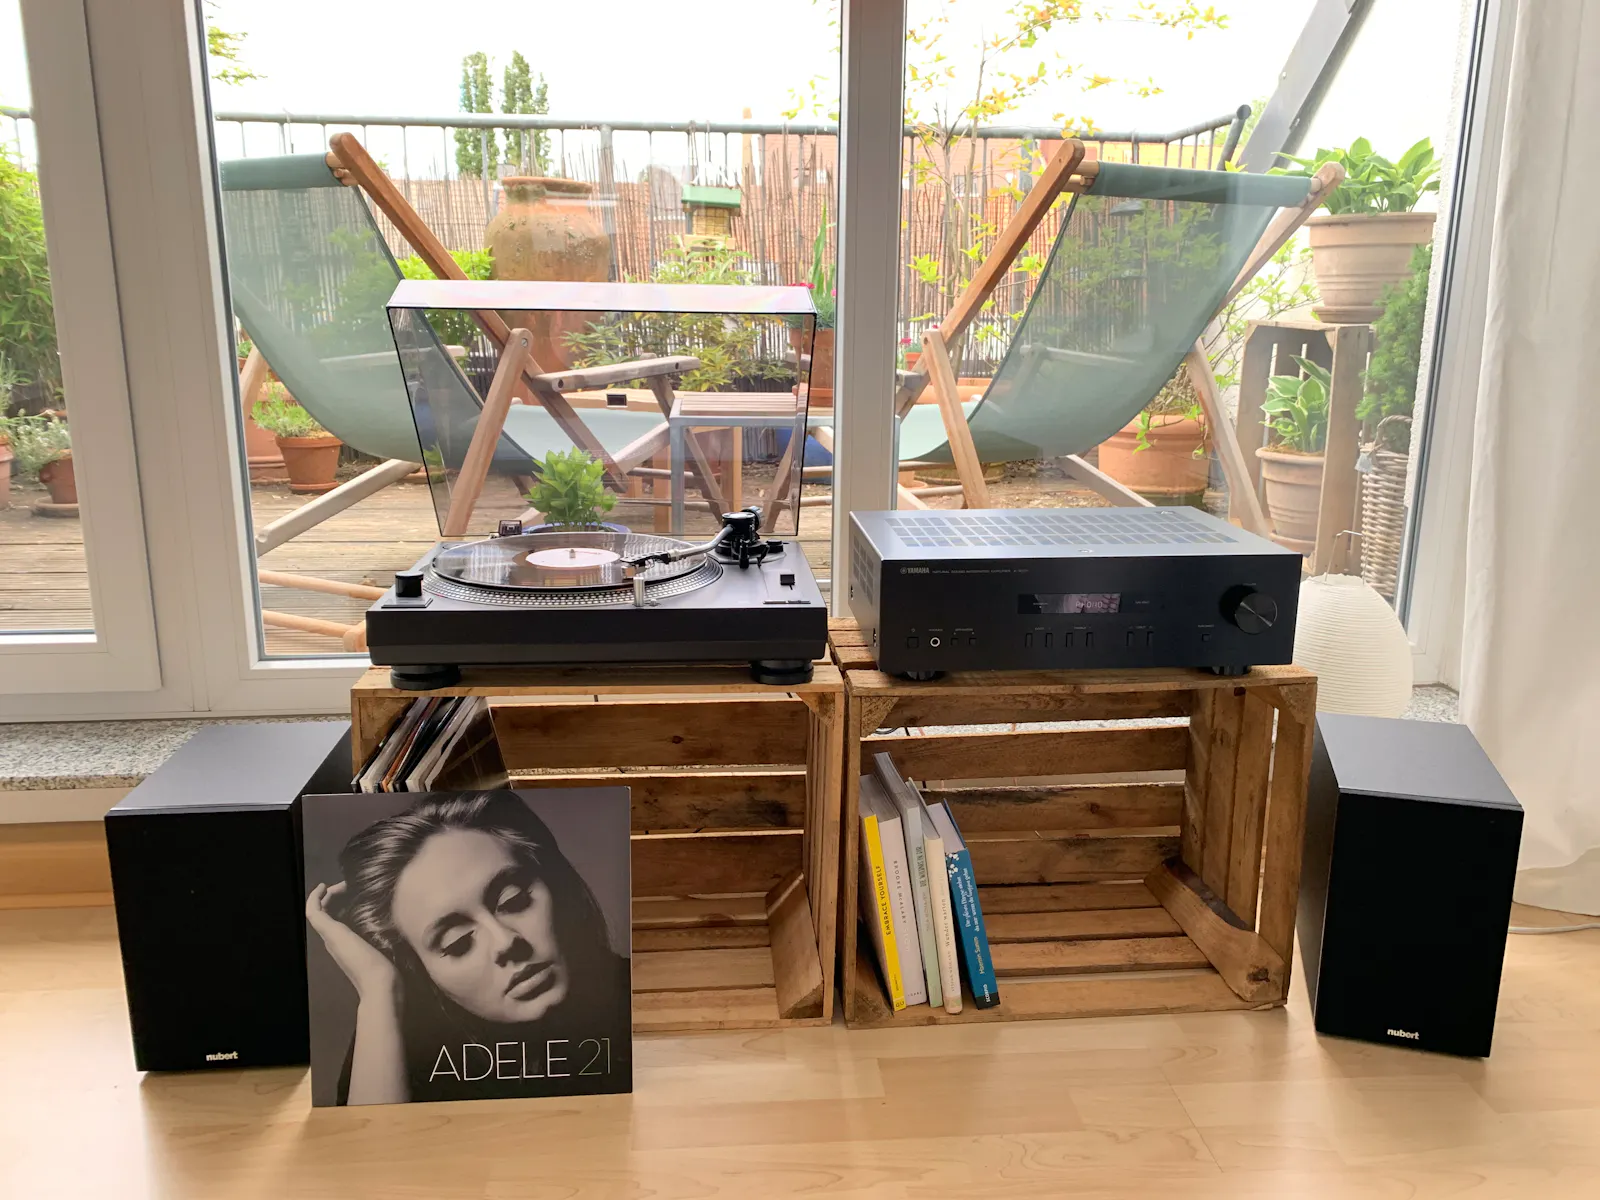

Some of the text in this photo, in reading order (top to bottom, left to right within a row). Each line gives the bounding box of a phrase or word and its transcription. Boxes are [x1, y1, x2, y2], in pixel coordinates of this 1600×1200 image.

[906, 566, 929, 574] YAMAHA
[1075, 601, 1103, 609] PHONO
[893, 860, 902, 890] BROOKE
[875, 865, 891, 936] EMBRACE YOURSELF
[1387, 1029, 1420, 1040] nubert
[205, 1050, 239, 1061] nubert
[429, 1037, 611, 1082] ADELE 21
